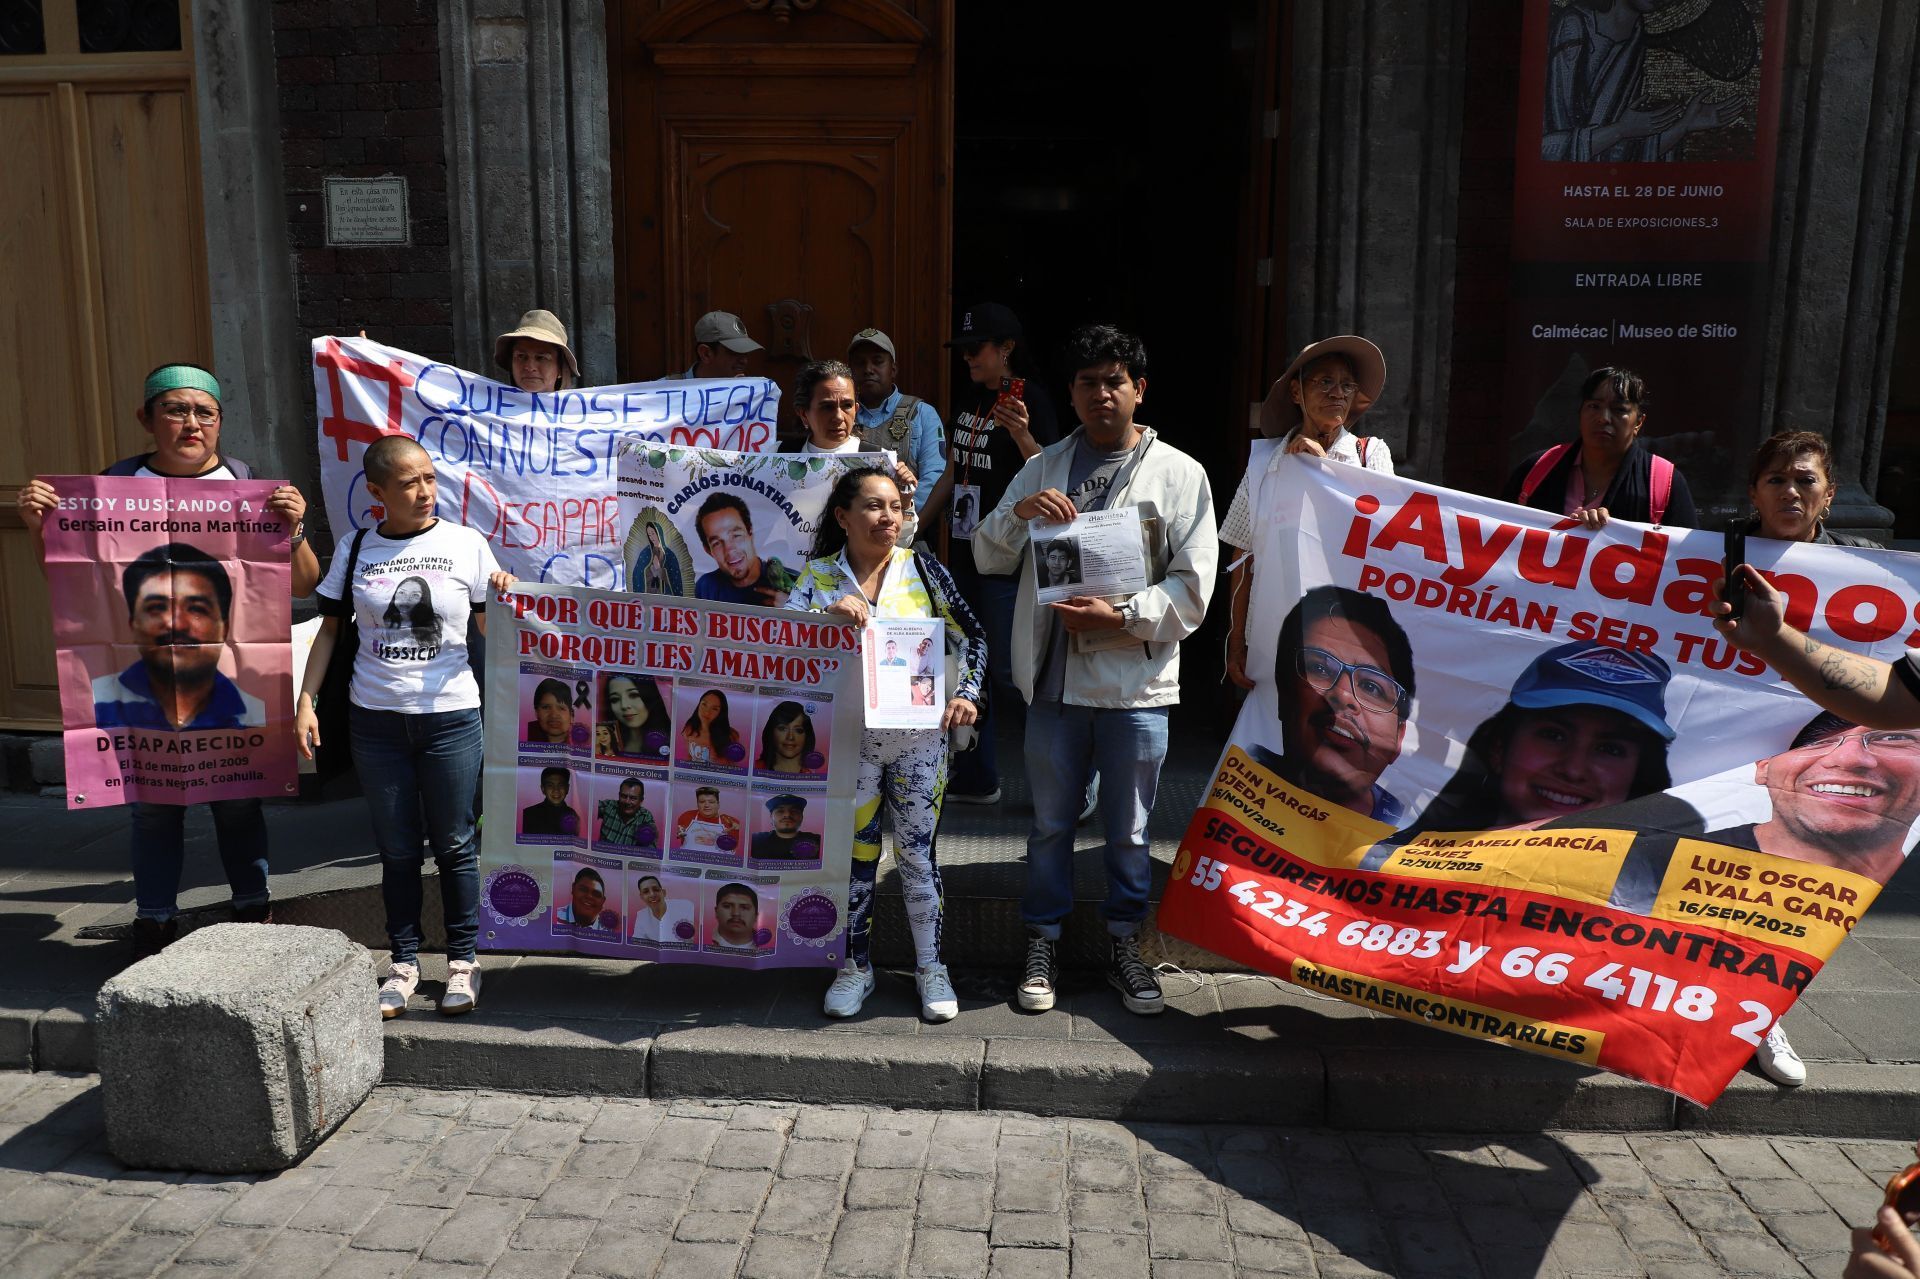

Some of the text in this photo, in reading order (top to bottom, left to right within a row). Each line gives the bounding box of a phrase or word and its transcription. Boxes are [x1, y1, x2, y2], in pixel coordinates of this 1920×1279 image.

[1564, 185, 1723, 197] HASTA EL 28 DE JUNIO
[1564, 217, 1719, 228] SALA DE EXPOSICIONES_3
[1575, 273, 1702, 287] ENTRADA LIBRE
[1532, 323, 1737, 338] Calmécac Museo de Sitio
[415, 363, 524, 416] QUE
[653, 380, 776, 426] JUEGUE
[418, 416, 492, 470] CON
[502, 422, 664, 481] NUEST
[617, 475, 664, 489] uscando nos
[57, 498, 117, 512] ESTOY
[126, 498, 232, 513] BUSCANDO
[239, 500, 252, 513] A
[667, 472, 802, 527] CARLOS JONATHAN
[59, 517, 281, 533] Gersain Cardona Martínez
[389, 564, 453, 573] ENCONTRARLE
[420, 557, 454, 566] JUNTAS
[1342, 491, 1920, 649] ¡Ayúdano
[589, 599, 642, 630] QUÉ
[653, 607, 698, 636] LES
[707, 613, 863, 655] BUSCAMOS,
[1358, 565, 1559, 634] PODRÍAN
[1567, 611, 1659, 658] SER
[1674, 632, 1767, 676] TUS
[379, 643, 437, 661] JESSICA
[519, 629, 636, 667] PORQUE
[645, 641, 693, 672] LES
[702, 648, 839, 684] AMAMOS”
[97, 734, 265, 754] DESAPARECIDO
[120, 760, 131, 770] El
[144, 760, 159, 771] de
[160, 762, 195, 773] marzo
[198, 759, 217, 771] del
[220, 757, 249, 767] 2009
[601, 765, 624, 774] Ermilo
[646, 771, 662, 779] Olea
[105, 777, 121, 787] en
[124, 774, 163, 788] Piedras
[166, 776, 208, 791] Negras,
[1218, 771, 1268, 810] OJEDA
[1226, 757, 1330, 822] OLIN VARGAS
[1415, 835, 1608, 853] ANA AMELI GARCÍA
[1203, 817, 1385, 905] SEGUIREMOS
[1390, 884, 1508, 921] HASTA
[1398, 858, 1484, 872] 12/JUL/2025
[1690, 854, 1858, 907] LUIS OSCAR
[1681, 877, 1774, 908] AYALA
[1678, 900, 1807, 938] 16/SEP/2025
[1190, 856, 1773, 1047] 55 4234 6883 y 66 4118 2
[1297, 965, 1589, 1054] #HASTAENCONTRARLES
